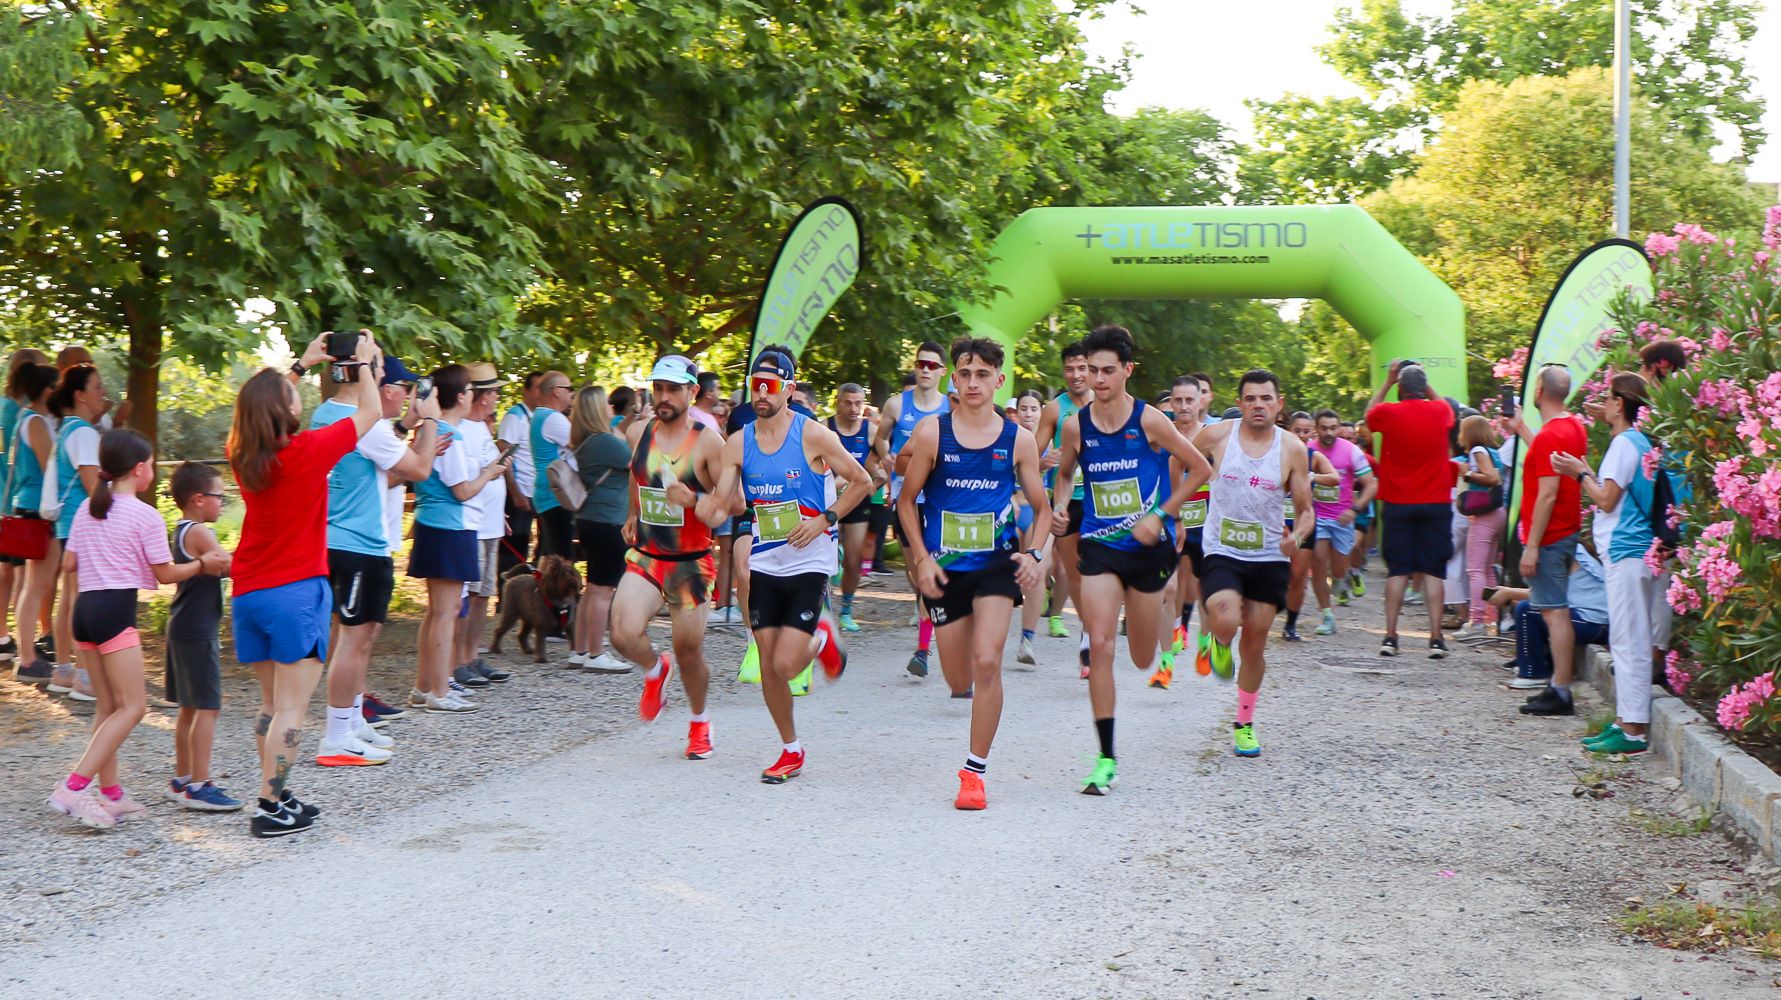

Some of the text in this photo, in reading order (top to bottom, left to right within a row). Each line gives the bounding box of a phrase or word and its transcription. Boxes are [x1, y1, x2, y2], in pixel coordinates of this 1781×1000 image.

[1111, 253, 1270, 265] www.masatletismo.com
[1088, 459, 1138, 472] enerplus
[945, 478, 999, 491] enerplus
[1101, 491, 1133, 507] 100
[772, 516, 781, 530] 1
[958, 526, 978, 540] 11
[1226, 529, 1257, 543] 208
